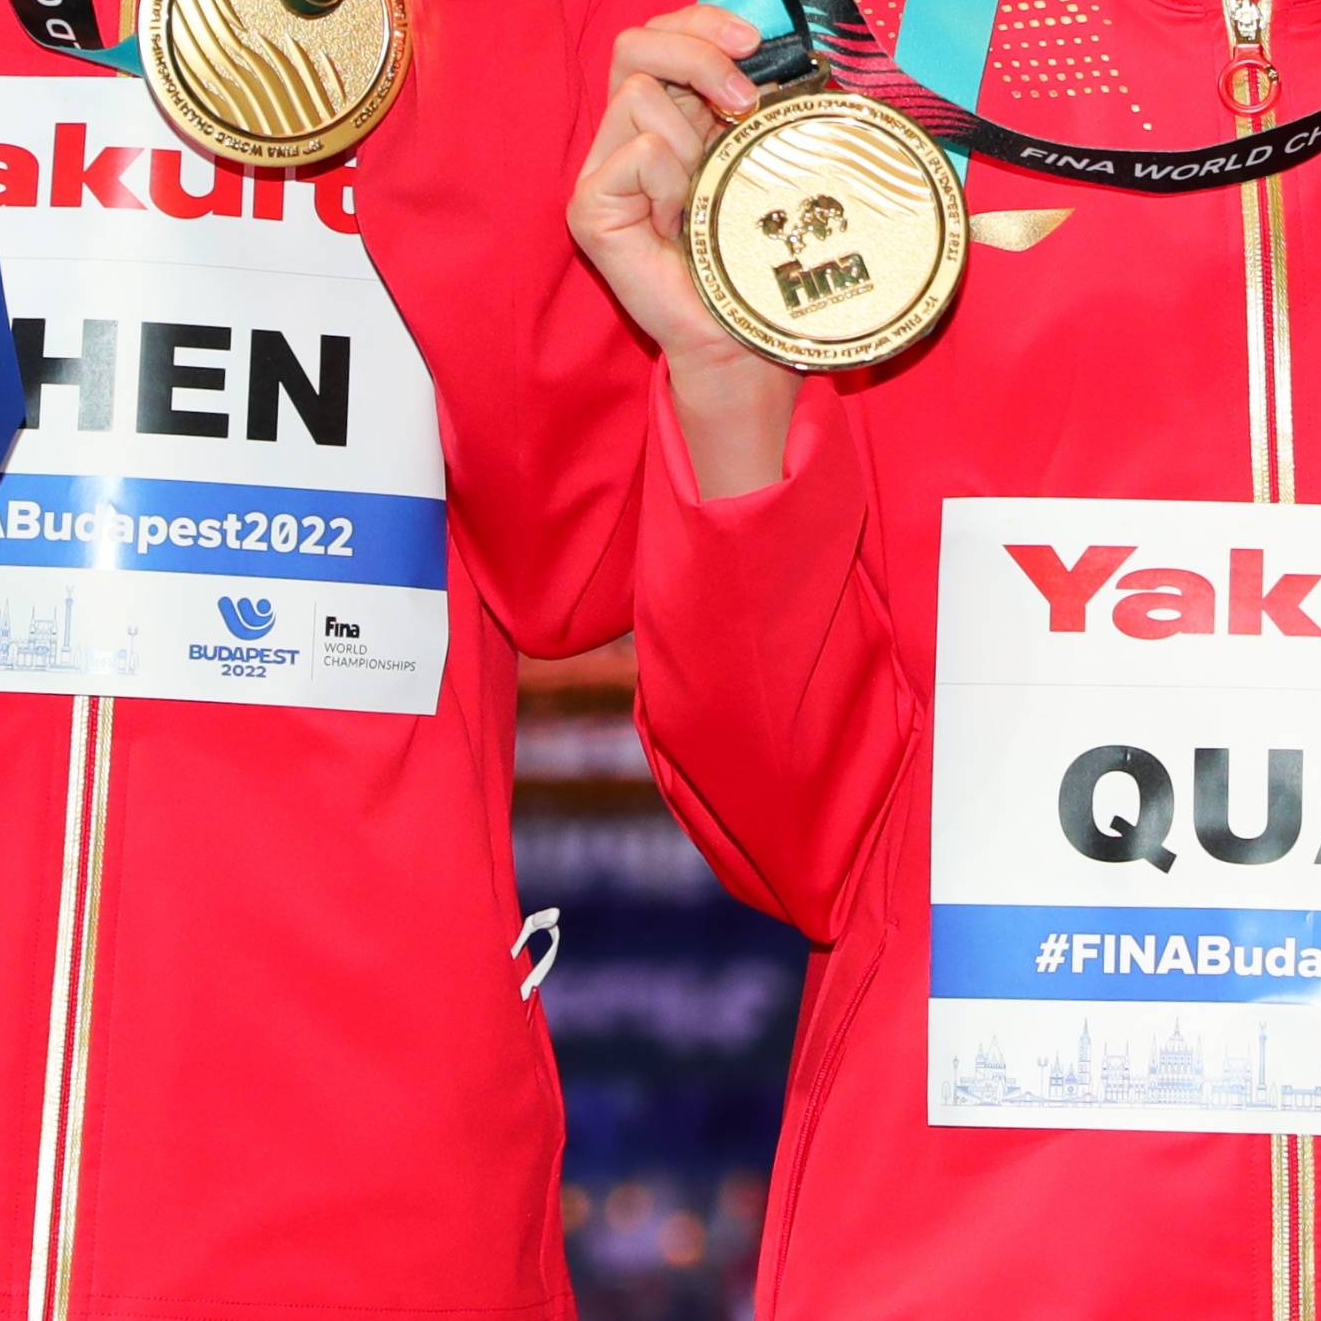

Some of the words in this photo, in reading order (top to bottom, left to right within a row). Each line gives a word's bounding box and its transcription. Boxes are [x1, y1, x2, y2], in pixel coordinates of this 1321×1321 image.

[1019, 146, 1116, 175] FINA
[1132, 144, 1275, 181] WORLD
[324, 616, 360, 639] Fina
[188, 644, 300, 665] BUDAPEST
[324, 642, 367, 656] WORLD
[221, 663, 267, 678] 2022
[323, 656, 416, 672] CHAMPIONSHIPS
